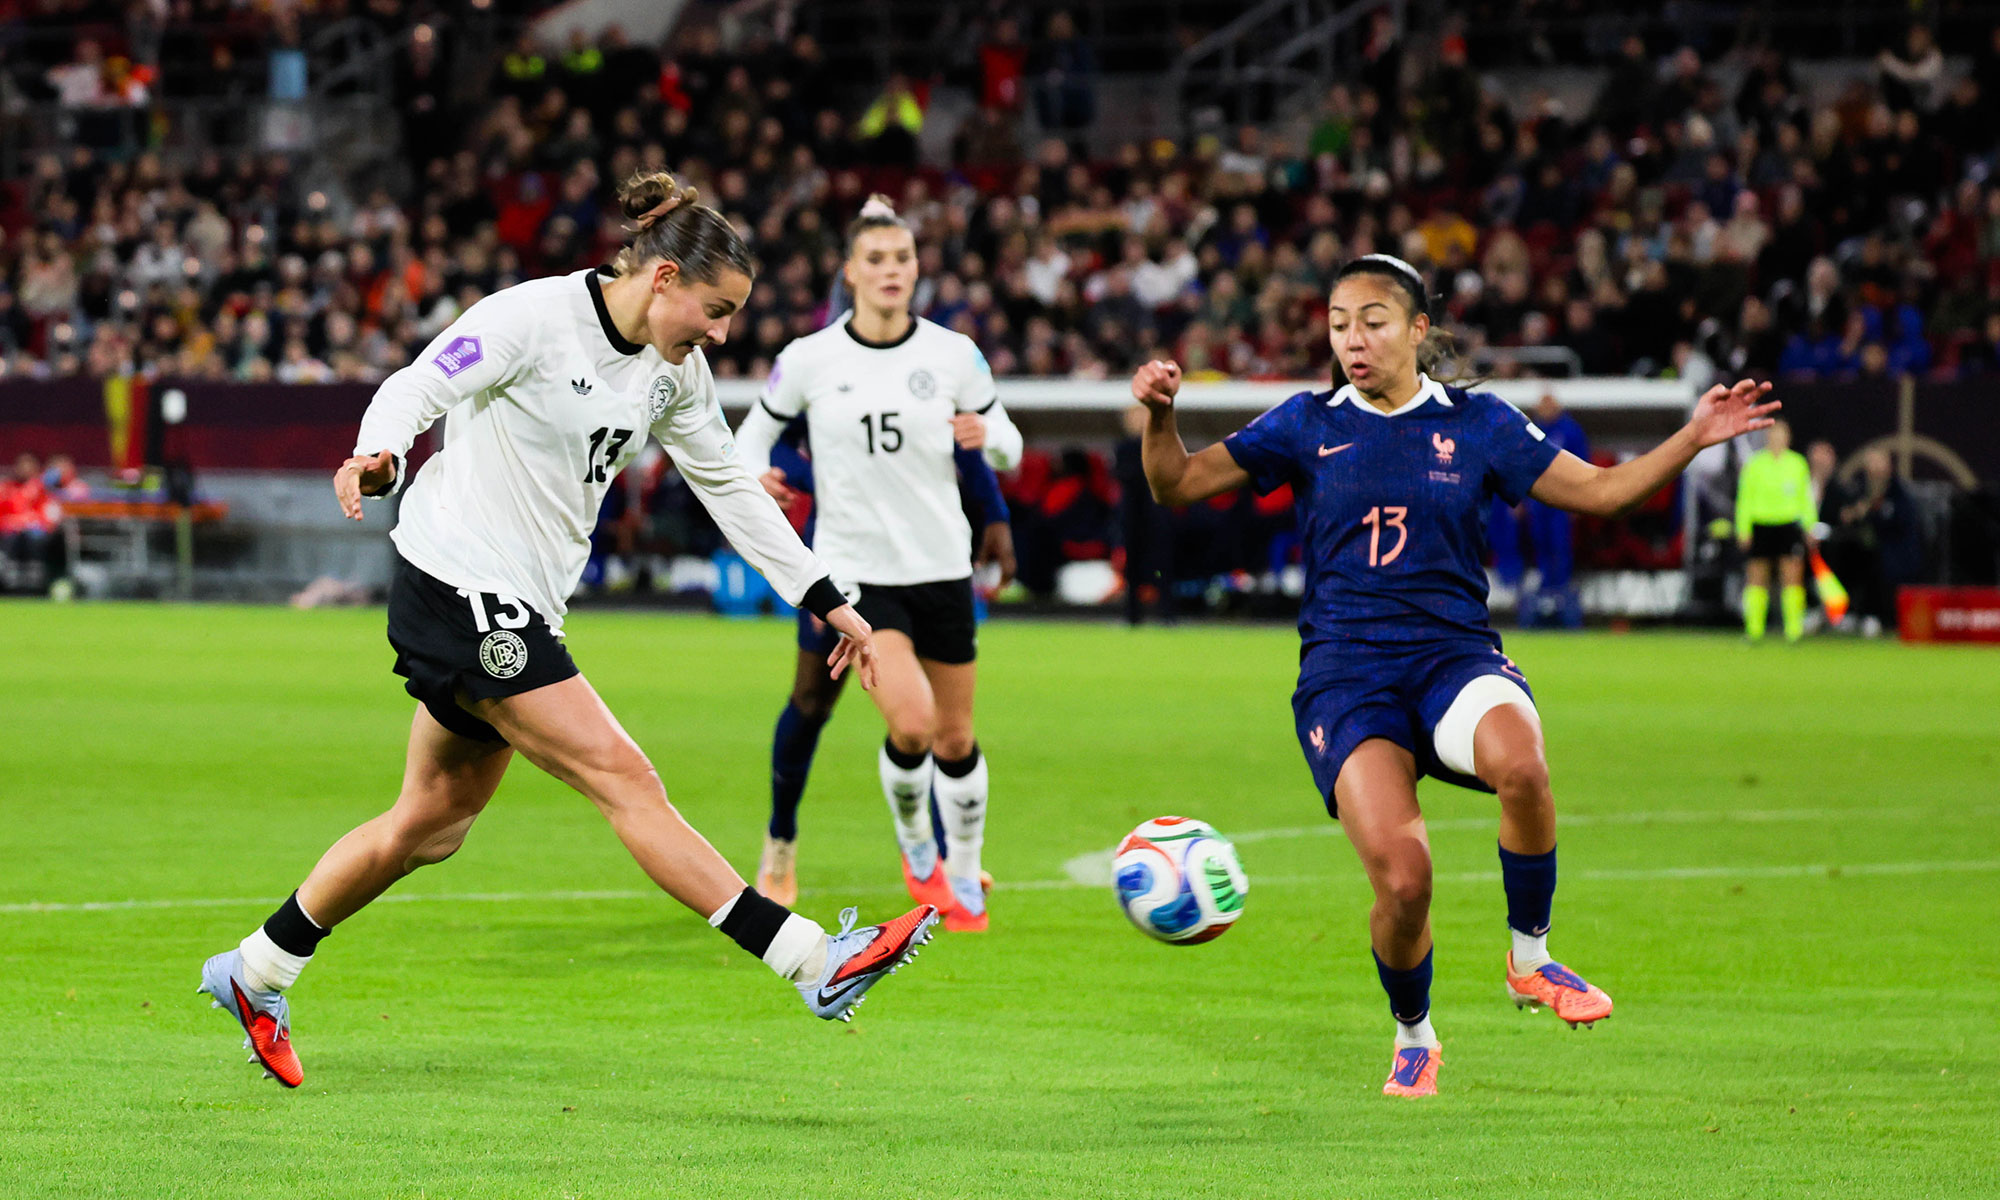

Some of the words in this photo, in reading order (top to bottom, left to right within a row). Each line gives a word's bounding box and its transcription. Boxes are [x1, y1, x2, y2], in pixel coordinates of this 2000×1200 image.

[584, 427, 634, 483] 13
[861, 412, 904, 454] 15
[1362, 506, 1408, 567] 13
